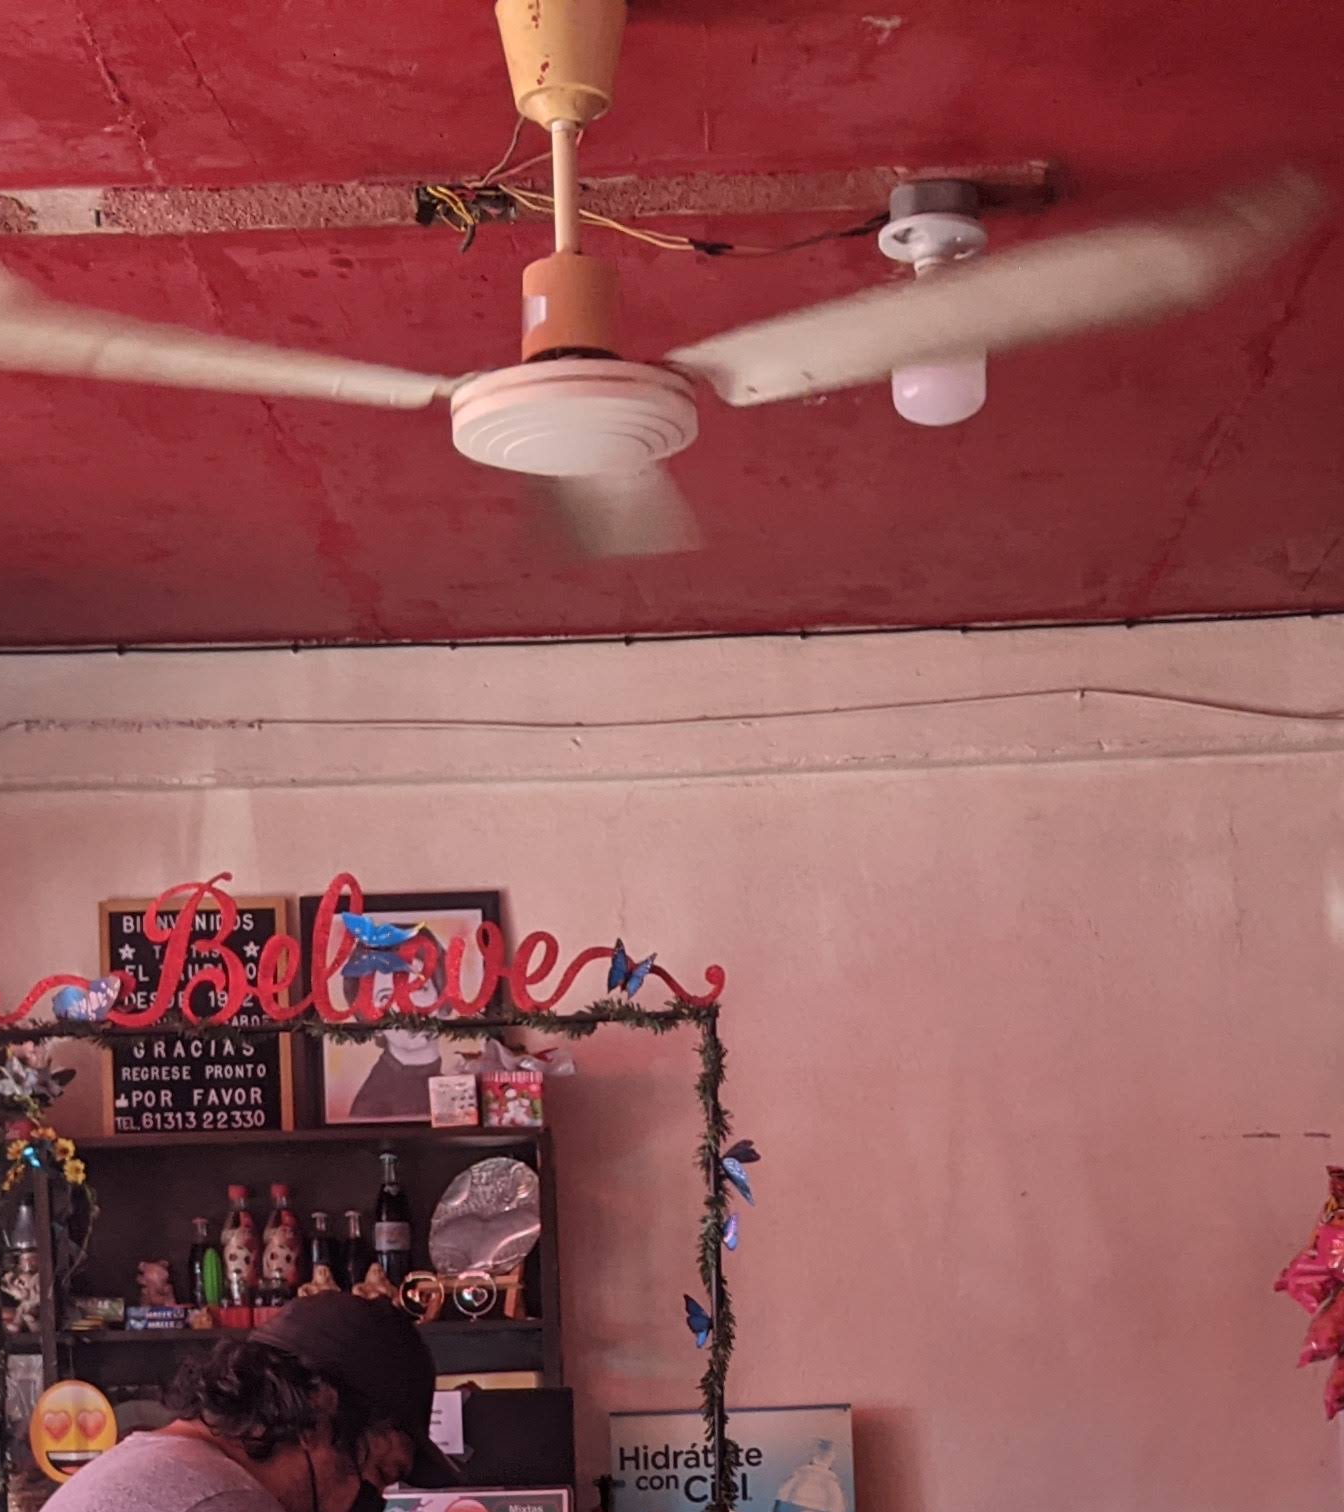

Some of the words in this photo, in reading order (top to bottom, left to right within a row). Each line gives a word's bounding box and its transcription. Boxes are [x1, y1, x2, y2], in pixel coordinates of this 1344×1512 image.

[123, 914, 254, 932] BINVNIDOS
[133, 1040, 254, 1058] GRACIAS
[122, 1066, 191, 1081] REGRESE
[206, 1064, 267, 1080] PRONTO
[132, 1090, 172, 1107] POR
[193, 1087, 262, 1106] FAVOR
[619, 1443, 763, 1471] Hidrátte
[636, 1474, 679, 1491] con
